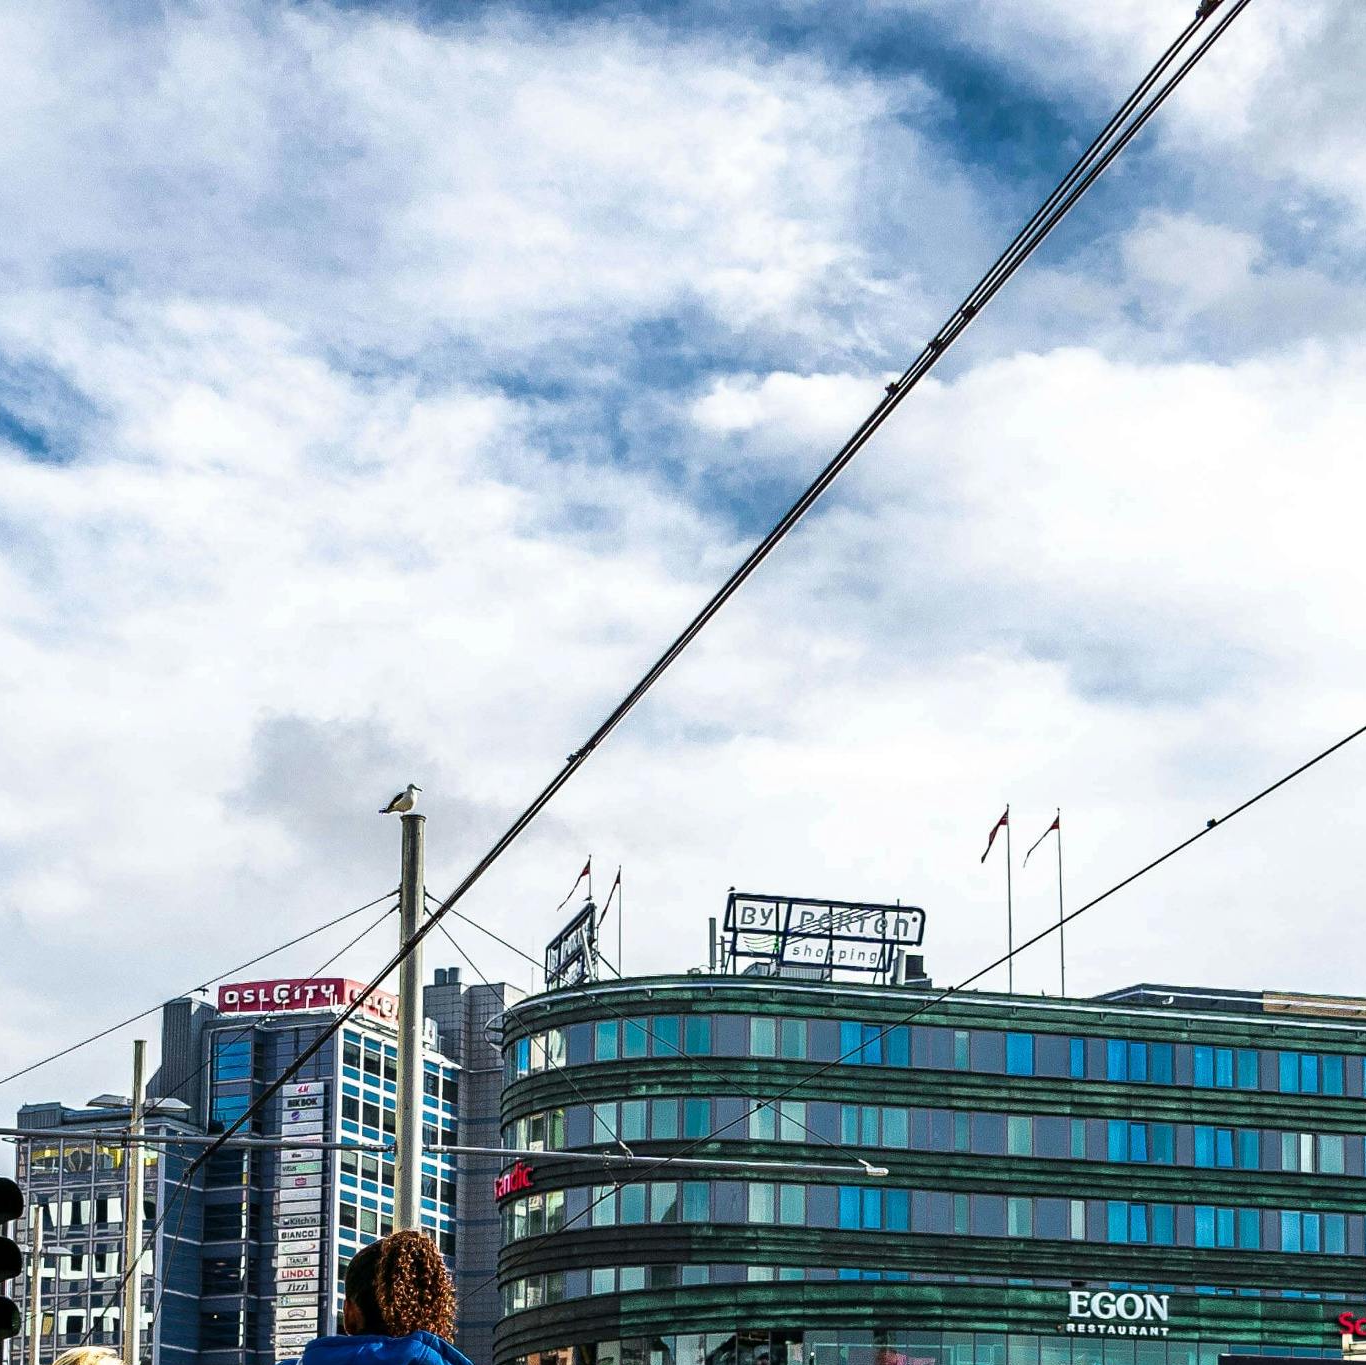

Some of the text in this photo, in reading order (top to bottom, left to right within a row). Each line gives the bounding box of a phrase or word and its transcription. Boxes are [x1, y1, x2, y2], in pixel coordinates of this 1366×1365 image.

[792, 944, 878, 963] shopping
[281, 1230, 314, 1239] BIANCO
[281, 1269, 315, 1278] LINDEX
[1068, 1291, 1170, 1321] EGON
[1066, 1323, 1170, 1336] RESTAURANT
